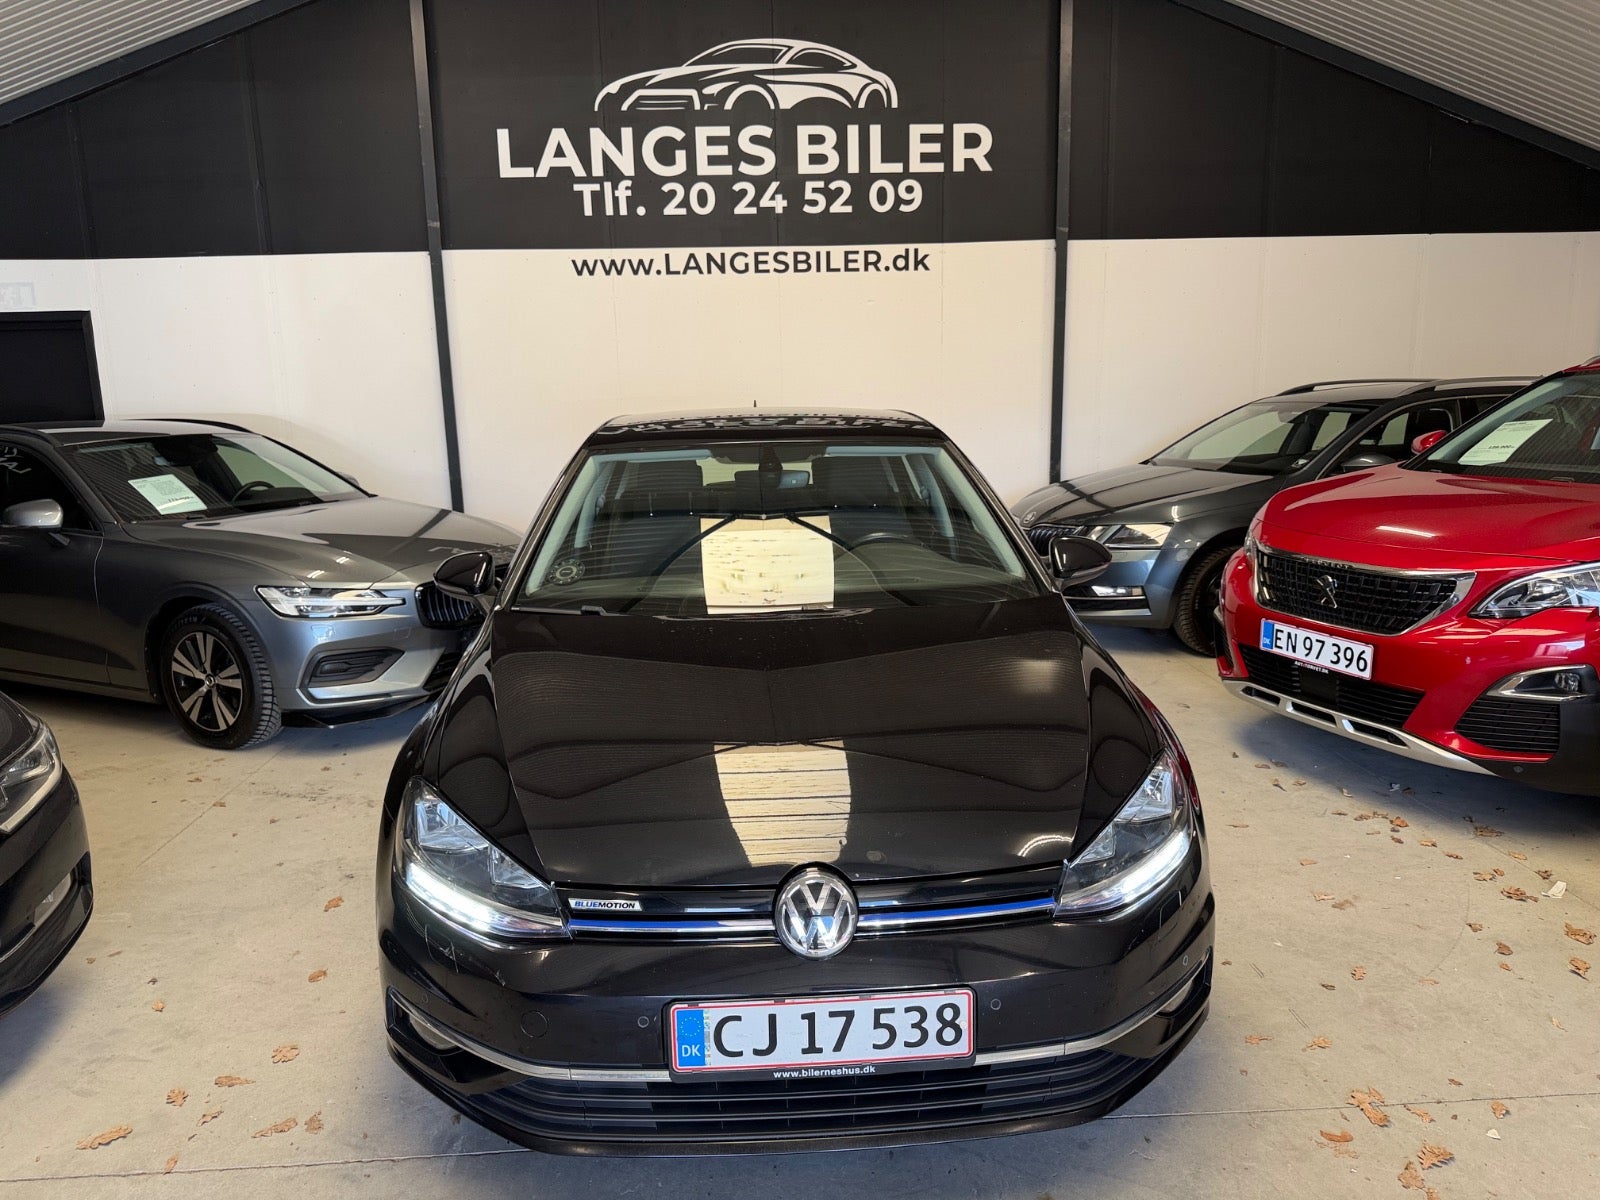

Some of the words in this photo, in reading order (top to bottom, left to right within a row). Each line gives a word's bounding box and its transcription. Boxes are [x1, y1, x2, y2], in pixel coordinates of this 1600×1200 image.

[496, 125, 776, 179] LANGES
[797, 122, 994, 175] BILER
[573, 180, 647, 217] Tlf.
[660, 181, 717, 216] 20
[731, 180, 788, 215] 24
[802, 180, 854, 214] 52
[868, 178, 924, 213] 09
[571, 248, 930, 276] www.LANGESBILER.dk
[1274, 628, 1298, 654] EN
[1303, 636, 1326, 660] 97
[1330, 643, 1368, 673] 396
[574, 900, 636, 909] BLUEMOTION
[713, 1013, 778, 1058] CJ
[800, 1009, 856, 1055] 17
[872, 1002, 963, 1050] 538
[681, 1044, 701, 1058] DK
[773, 1065, 876, 1079] www.bilerneshus.dk
